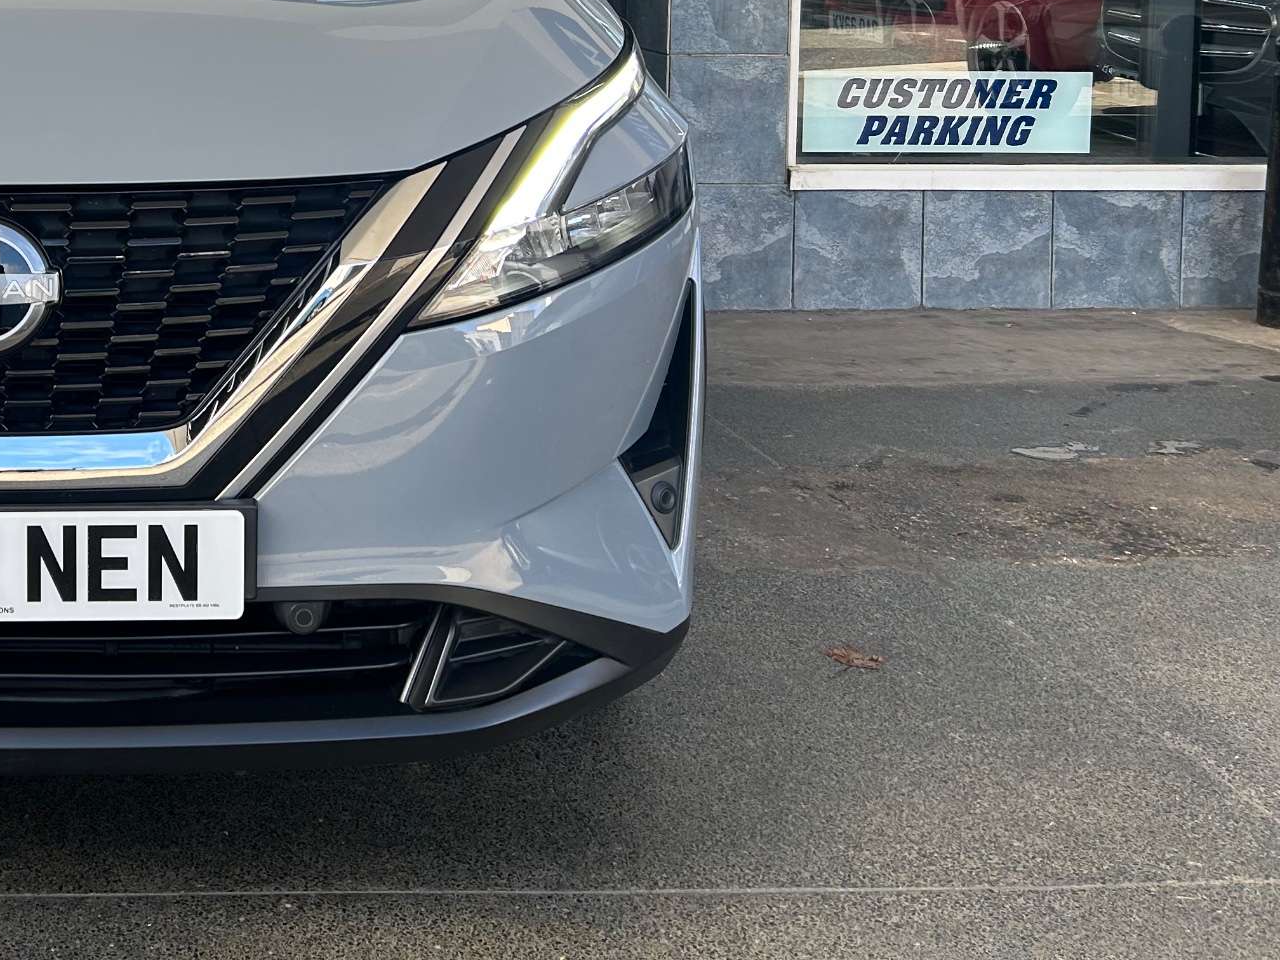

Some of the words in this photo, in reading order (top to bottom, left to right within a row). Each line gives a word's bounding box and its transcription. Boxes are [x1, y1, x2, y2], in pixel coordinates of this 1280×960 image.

[837, 77, 1058, 110] CUSTOMER
[855, 115, 1036, 146] PARKING
[26, 524, 199, 602] NEN
